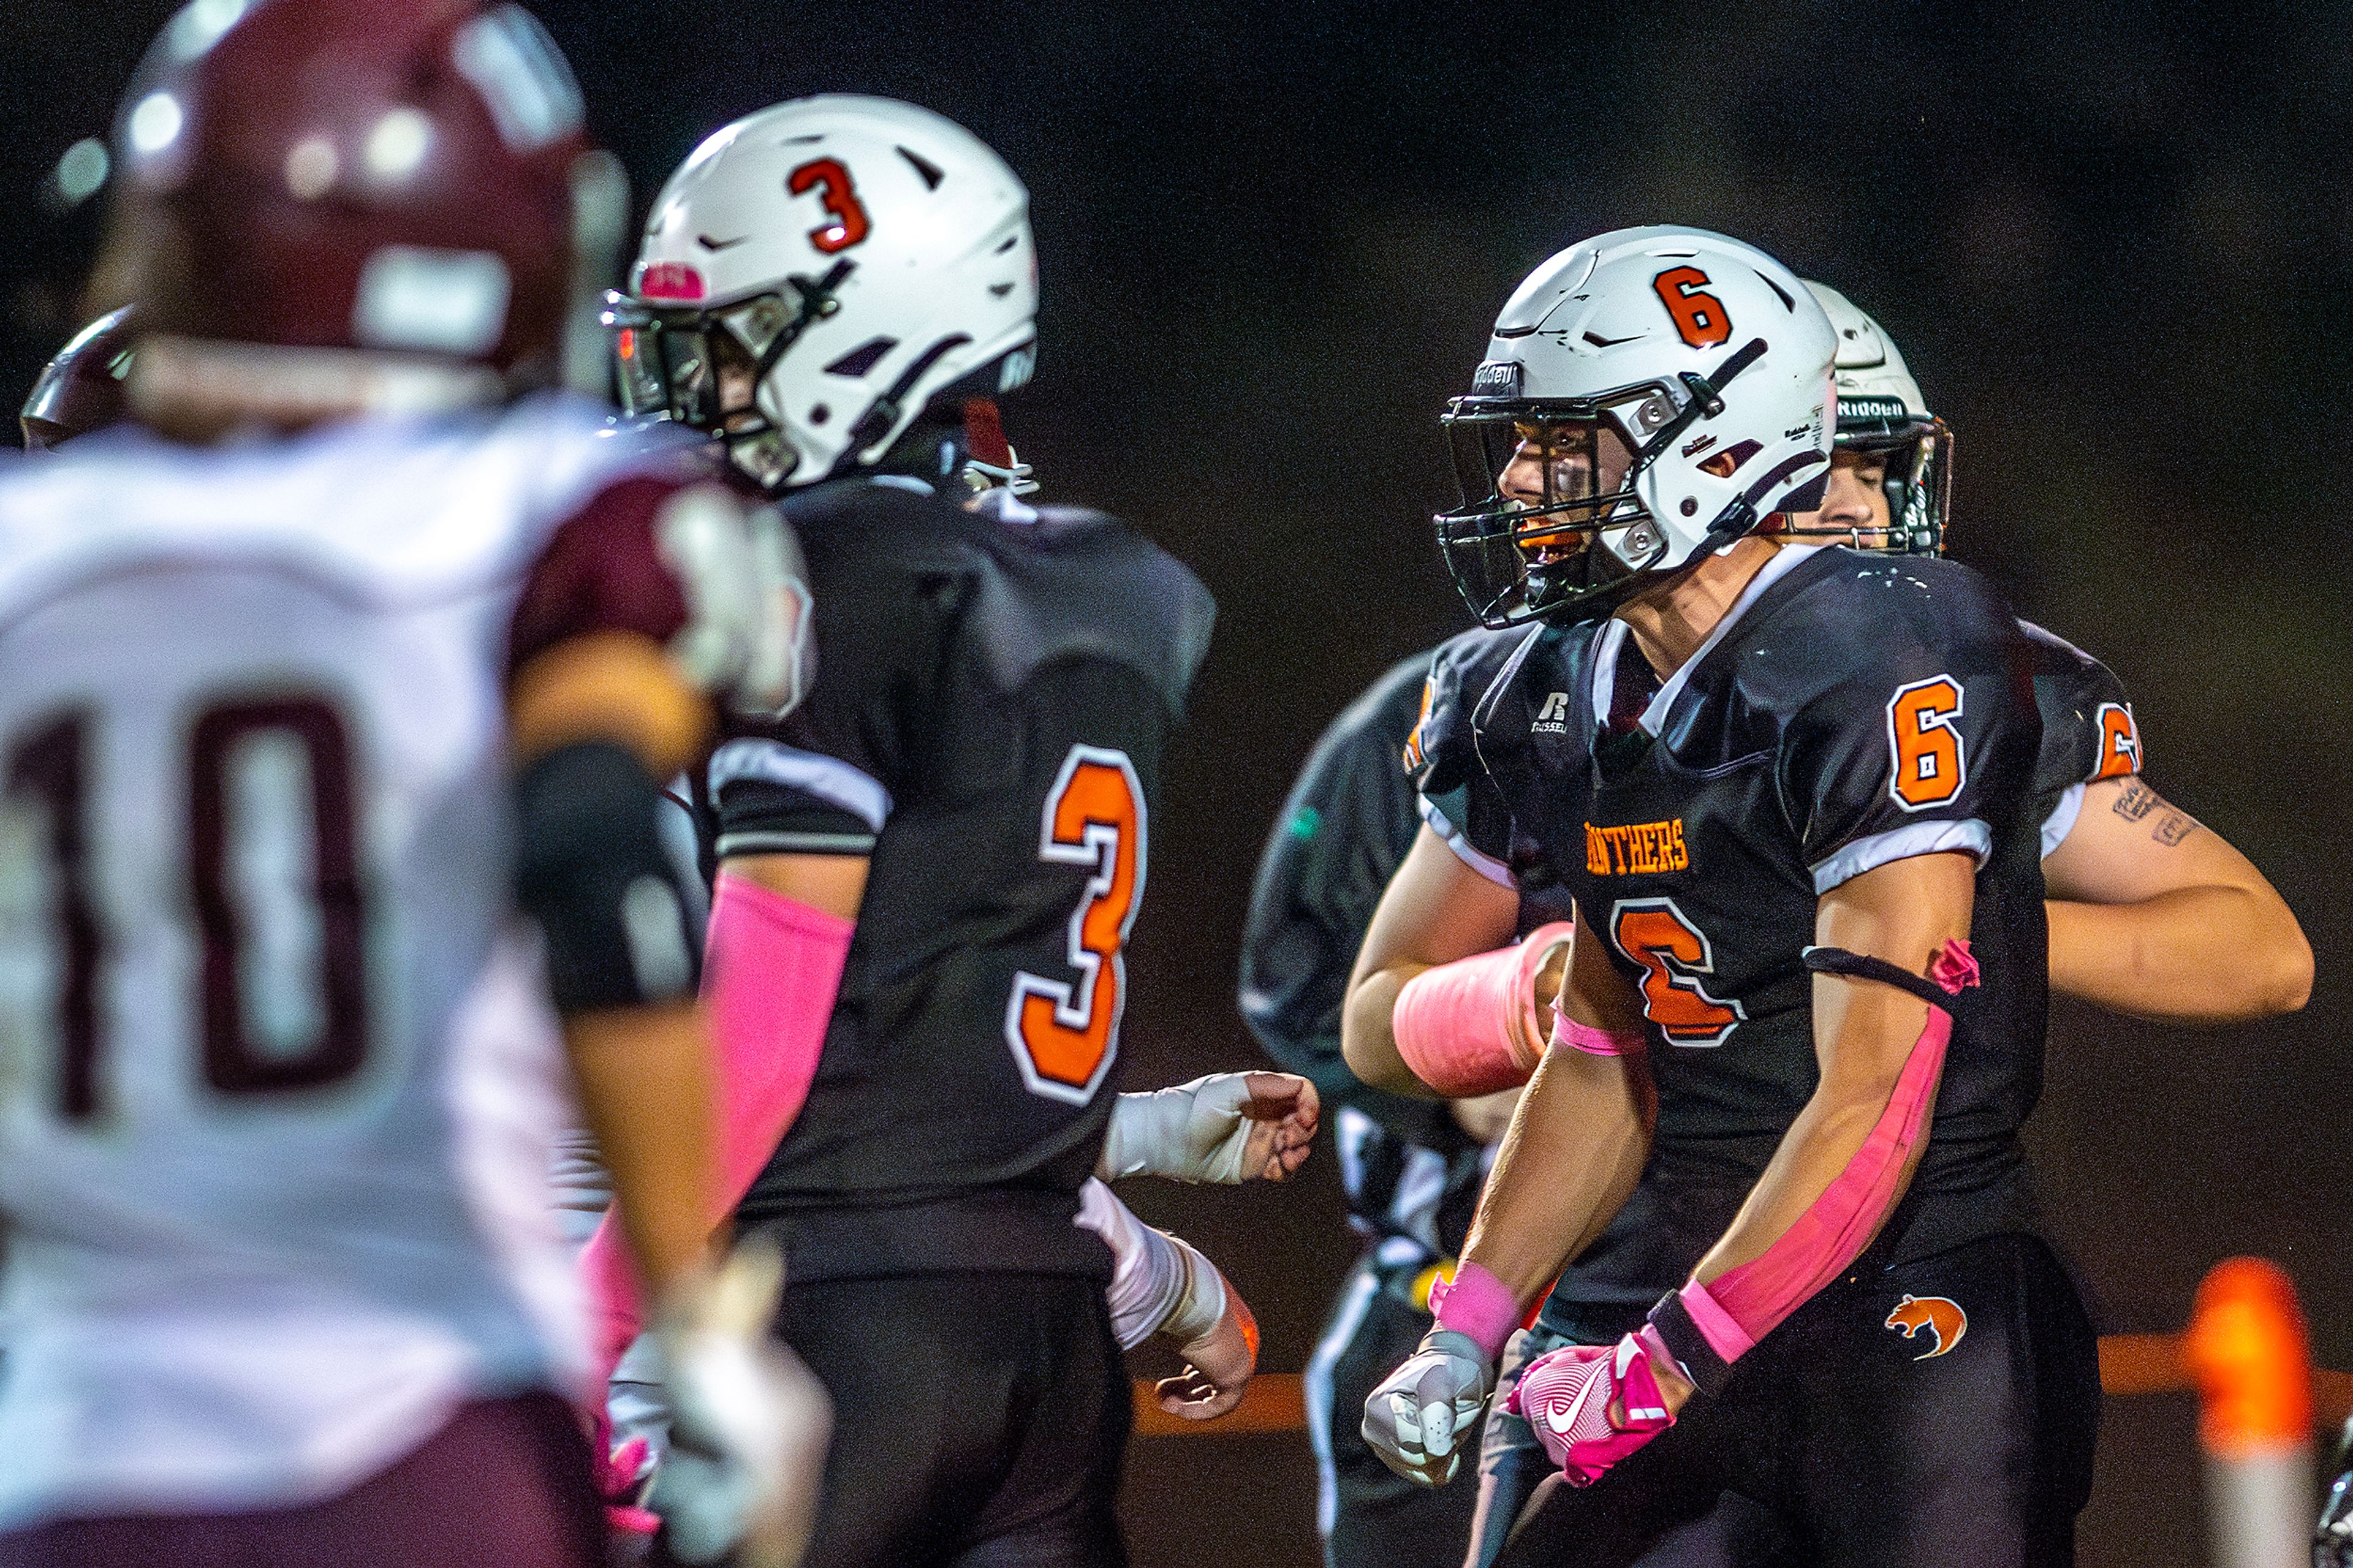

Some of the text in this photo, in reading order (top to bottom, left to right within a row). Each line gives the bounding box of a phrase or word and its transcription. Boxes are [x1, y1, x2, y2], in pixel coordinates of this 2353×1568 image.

[786, 154, 872, 254] 3
[1653, 265, 1733, 350] 6
[1838, 400, 1903, 417] Riddell
[1886, 673, 1966, 812] 6
[0, 692, 371, 1121] 10
[1004, 743, 1148, 1107] 3
